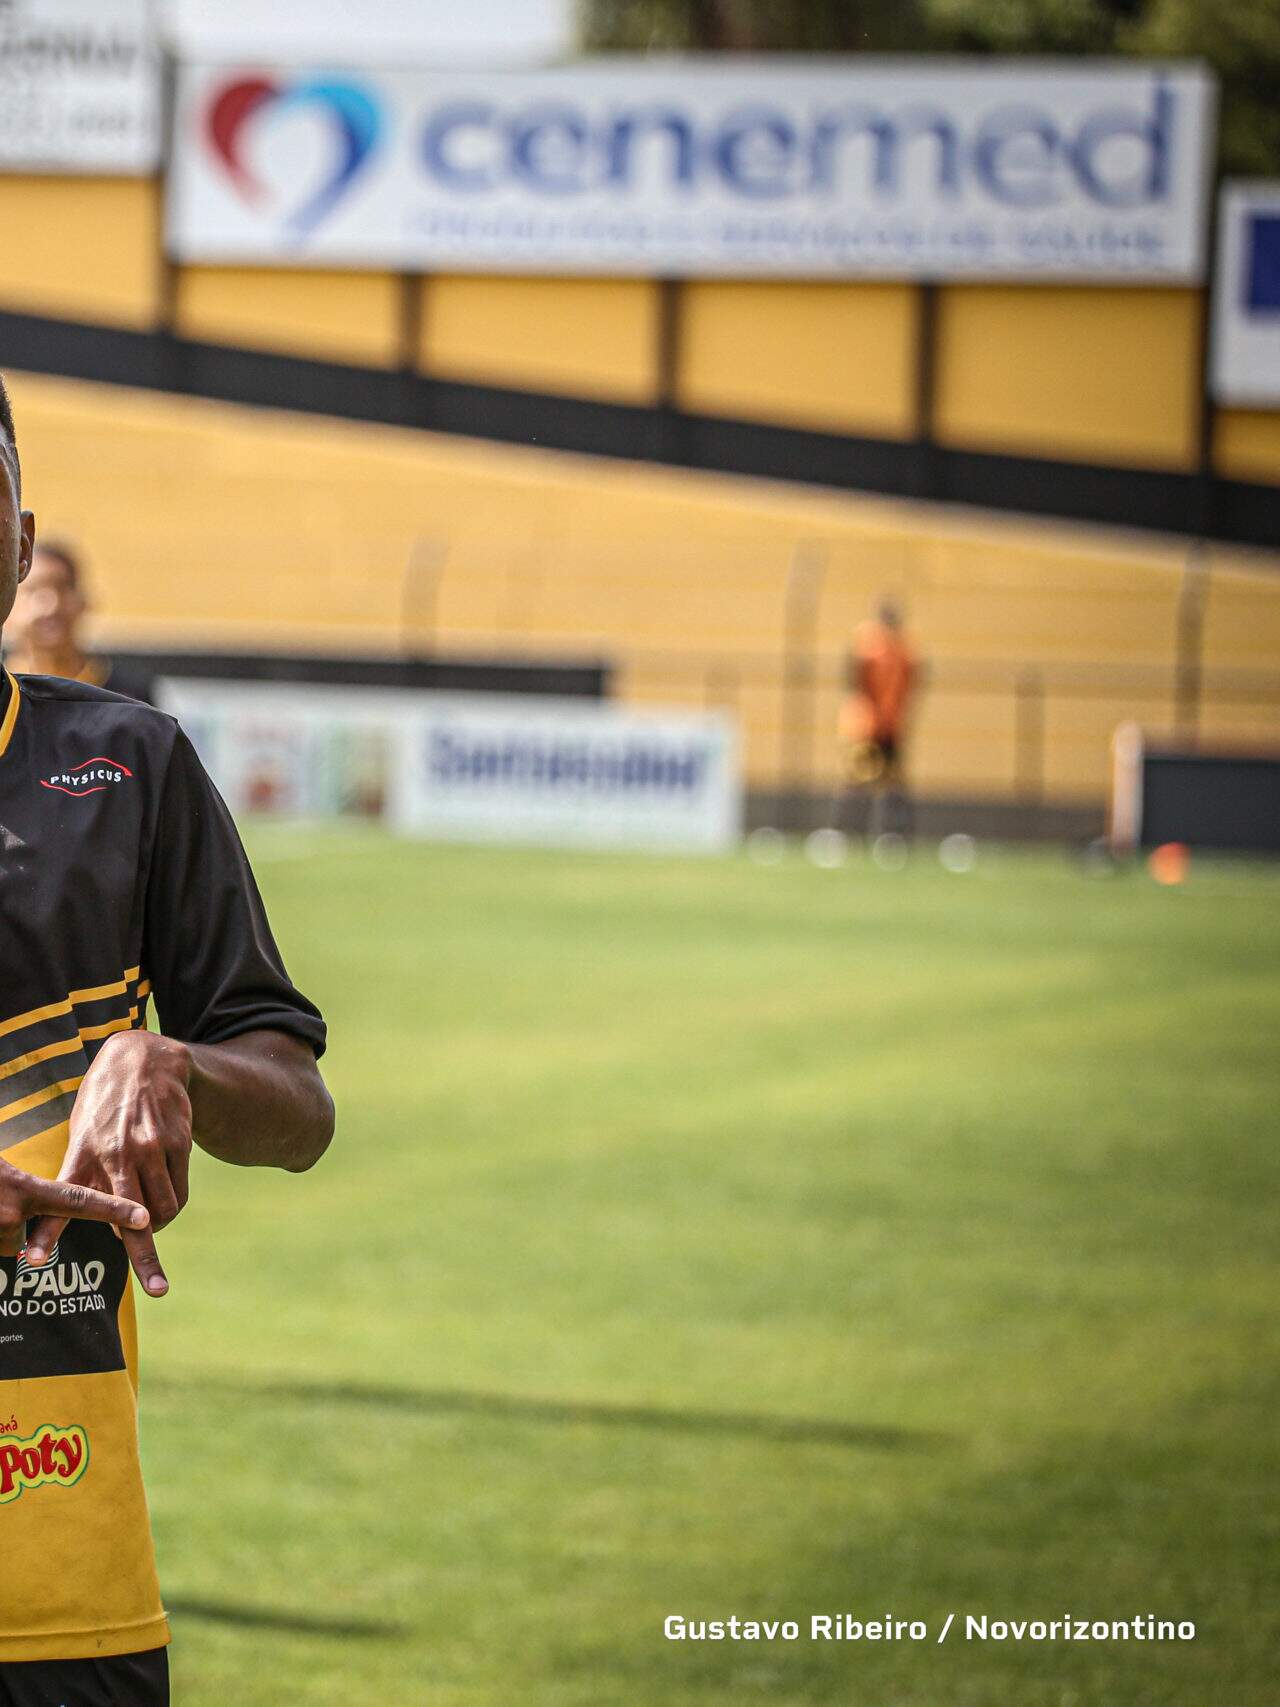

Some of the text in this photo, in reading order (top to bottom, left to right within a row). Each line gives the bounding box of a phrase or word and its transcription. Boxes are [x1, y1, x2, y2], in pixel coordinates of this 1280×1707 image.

[418, 84, 1176, 203] cenemed
[50, 770, 122, 786] PHYSICUS
[13, 1260, 106, 1298] PAULO
[26, 1299, 57, 1316] DO
